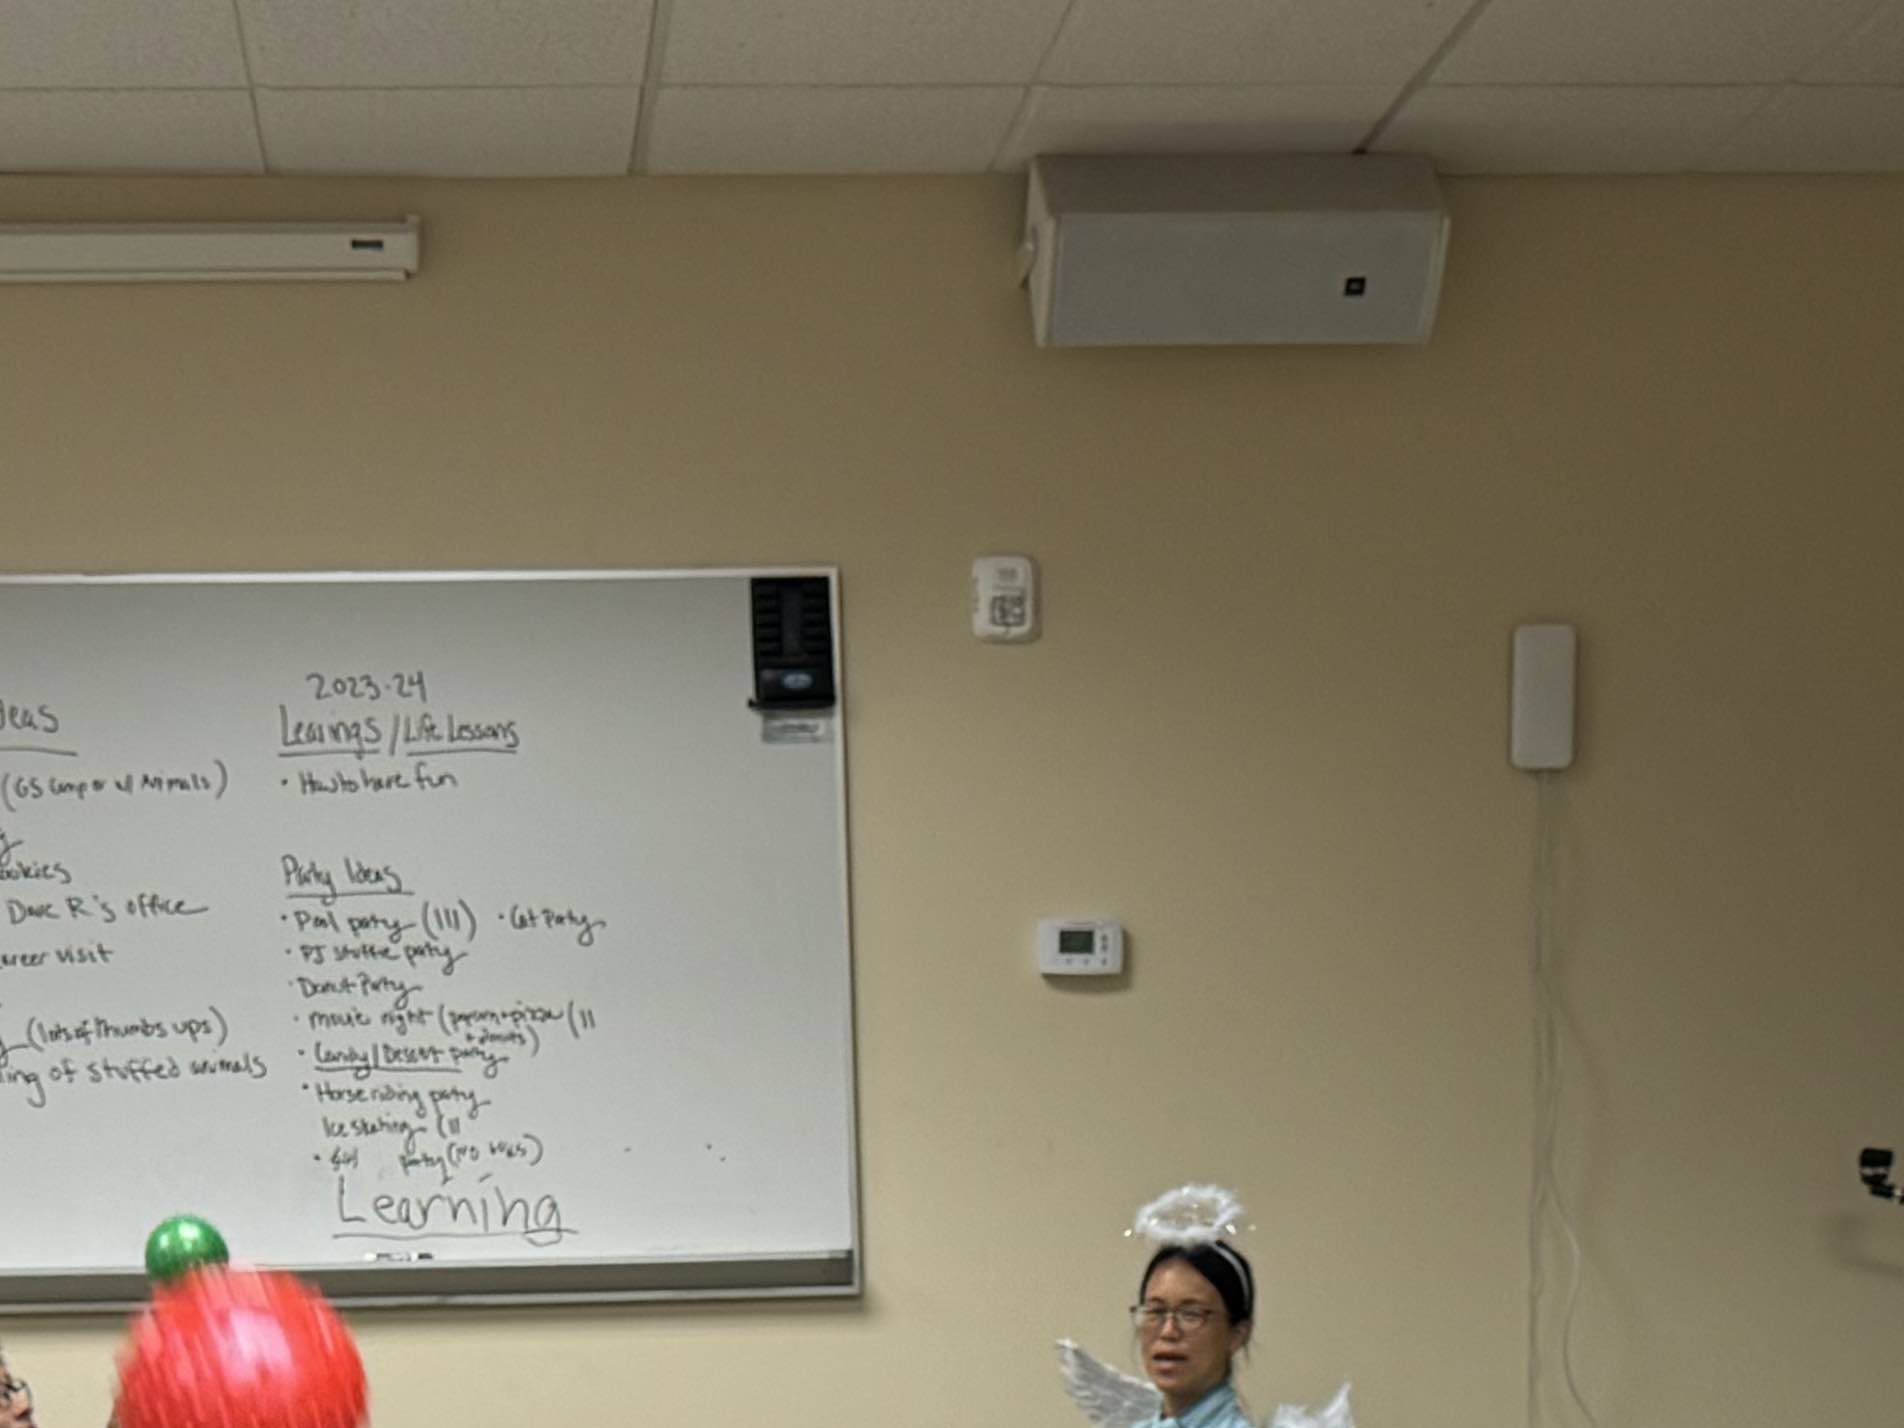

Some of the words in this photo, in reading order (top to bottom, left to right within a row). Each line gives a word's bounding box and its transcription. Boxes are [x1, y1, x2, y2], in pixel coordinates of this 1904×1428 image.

[415, 761, 460, 789] fun
[126, 892, 210, 917] office
[48, 1058, 78, 1086] of
[337, 1172, 564, 1248] Learning
